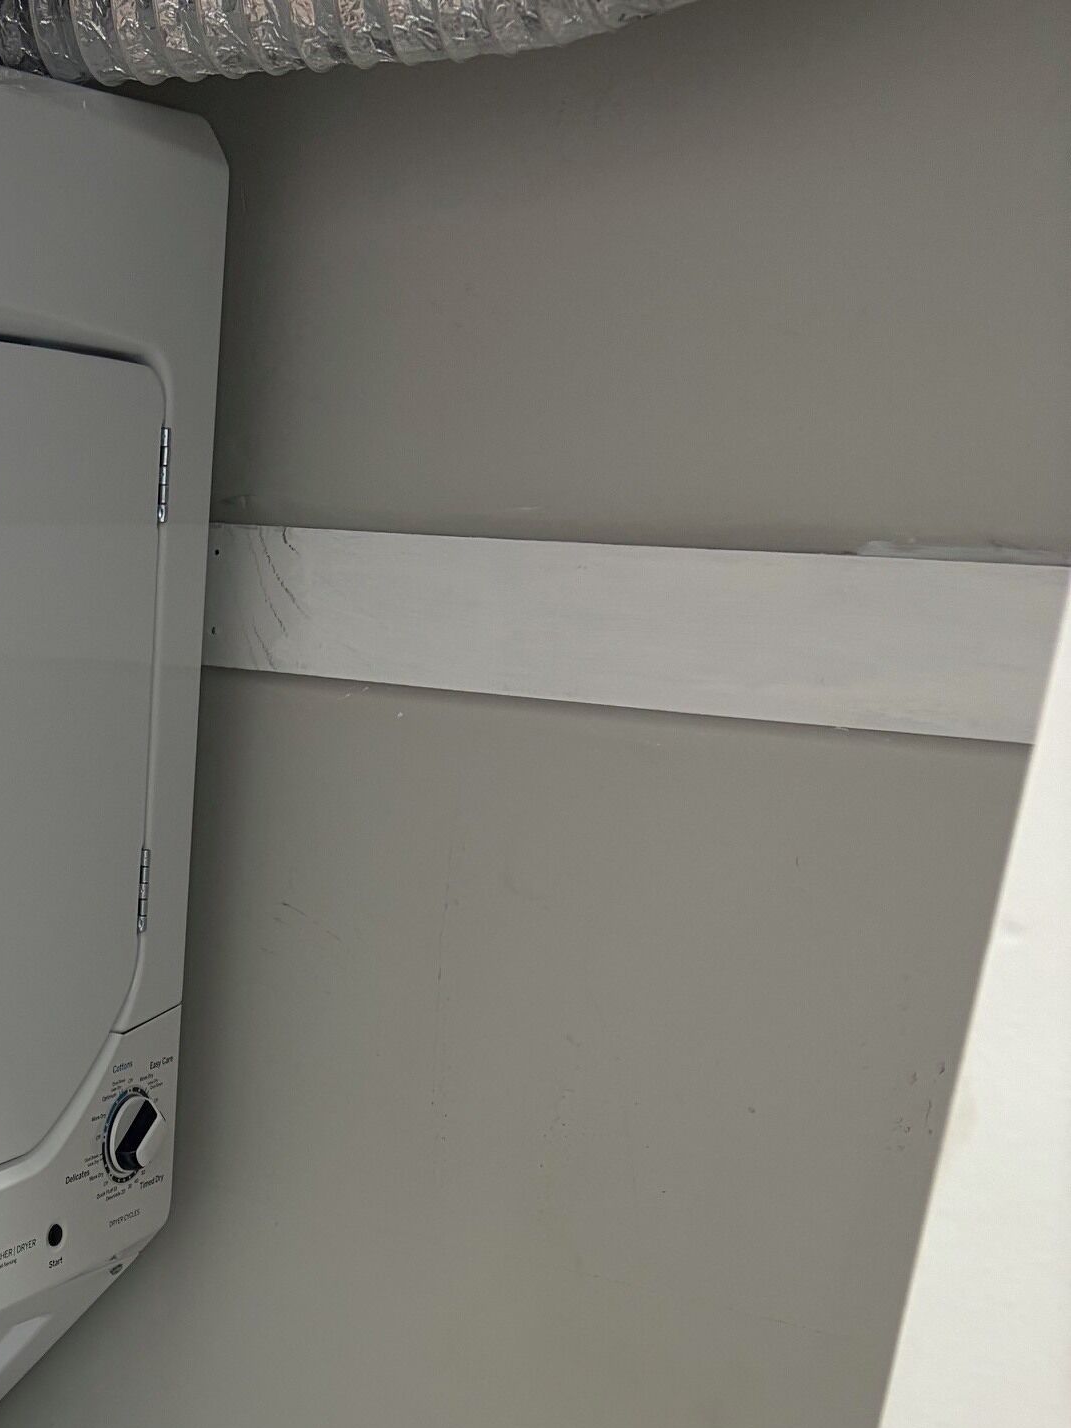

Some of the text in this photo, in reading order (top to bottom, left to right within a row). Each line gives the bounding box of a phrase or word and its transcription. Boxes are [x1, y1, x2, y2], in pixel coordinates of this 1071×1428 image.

[149, 1056, 174, 1069] Easy Care
[65, 1170, 90, 1184] Delicates
[139, 1179, 155, 1190] Timed
[154, 1174, 165, 1183] Dry
[16, 1238, 37, 1254] DRYER
[48, 1257, 63, 1269] Start
